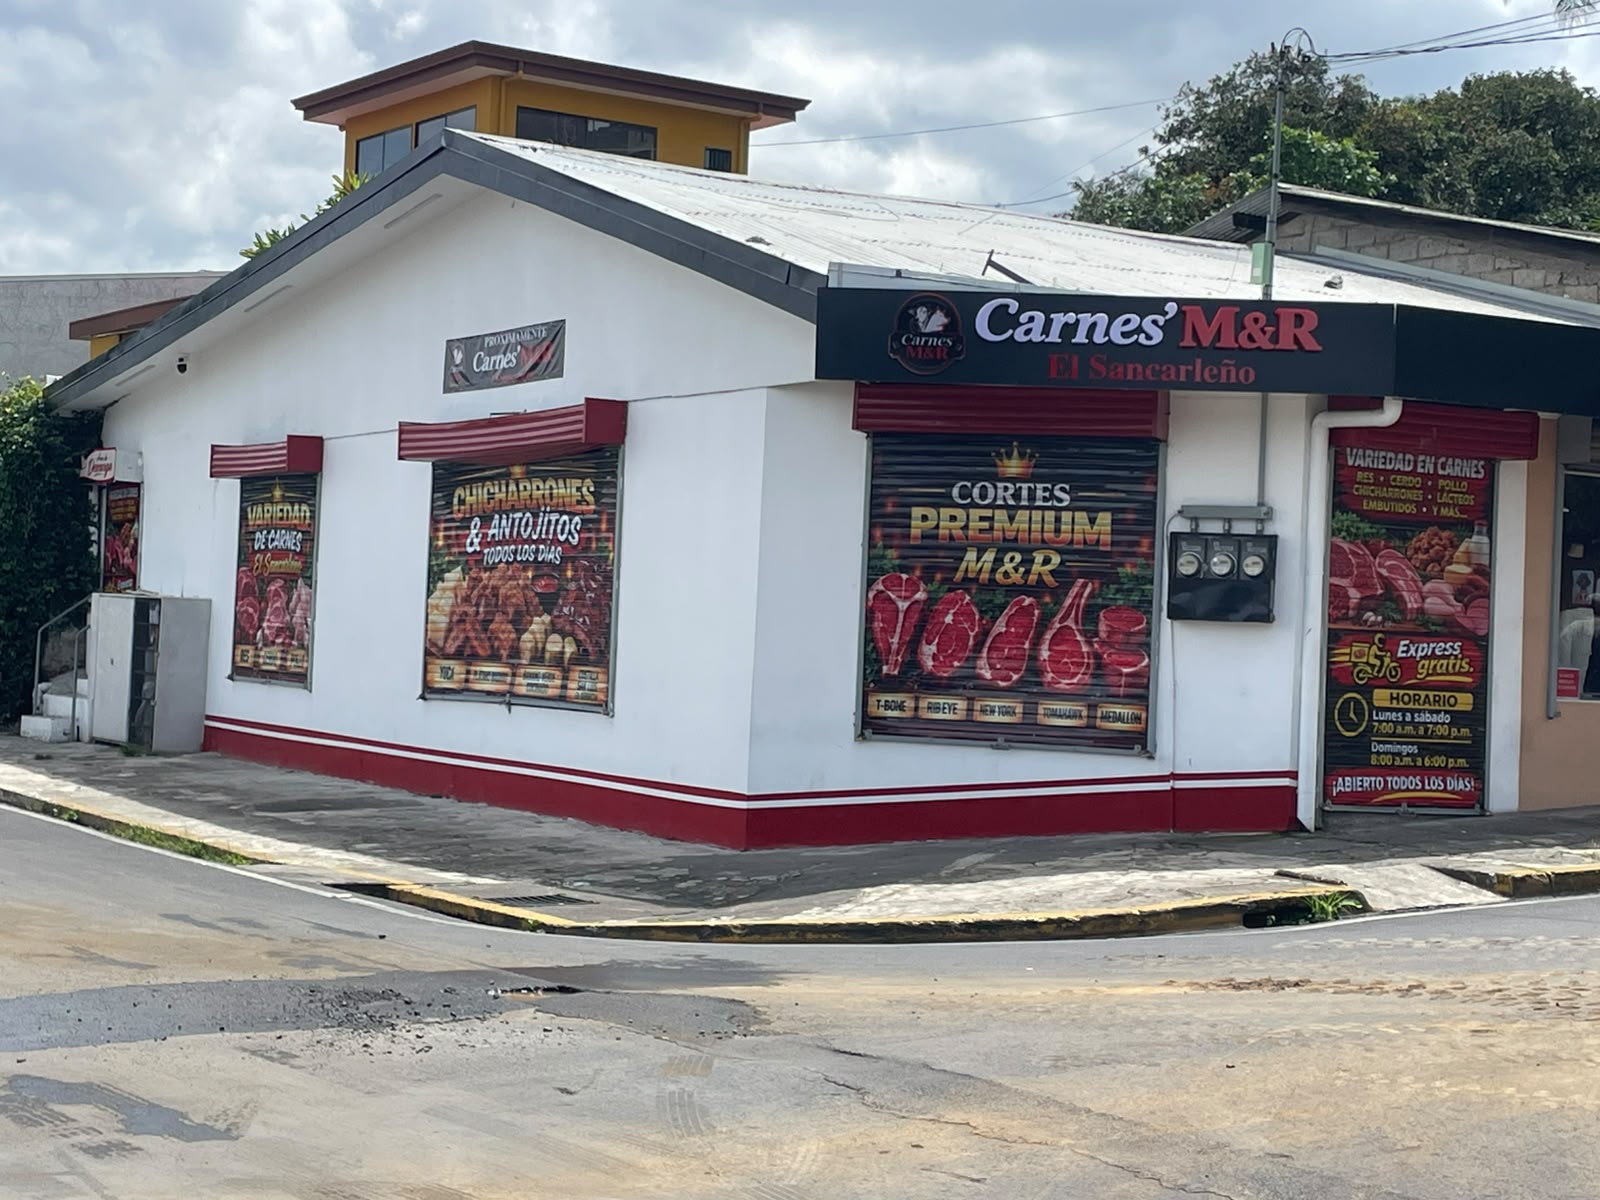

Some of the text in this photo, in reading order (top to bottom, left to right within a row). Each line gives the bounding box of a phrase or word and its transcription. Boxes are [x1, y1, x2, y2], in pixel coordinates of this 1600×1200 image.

[1180, 304, 1323, 352] M&R
[901, 333, 953, 347] Carnes
[906, 345, 949, 360] M&R
[1048, 354, 1256, 385] El Sancarleño
[1346, 448, 1486, 480] VARIEDAD EN CARNES
[1356, 471, 1468, 492] RES CERDO POLLO
[453, 477, 596, 520] CHICHARRONES
[951, 481, 1071, 507] CORTES
[1353, 484, 1424, 502] CHICHARRONES
[247, 503, 311, 527] VARIEDAD
[1363, 499, 1417, 514] EMBUTIDOS
[1432, 506, 1438, 516] Y
[466, 517, 482, 553] &
[909, 506, 1113, 551] PREMIUM
[254, 529, 303, 552] DE CARNES
[483, 545, 516, 565] TODOS
[516, 544, 536, 562] LOS
[953, 547, 1062, 588] M&R
[1397, 639, 1462, 661] Express
[876, 699, 906, 712] T-BONE
[1389, 692, 1458, 708] HORARIO
[979, 704, 1017, 718] NEW YORK
[1373, 710, 1451, 724] Lunes a sábado
[1372, 722, 1394, 734] 7:00
[1418, 726, 1424, 735] a
[1427, 724, 1449, 736] 7:00
[1451, 727, 1472, 739] p.m.
[1371, 742, 1418, 755] Domingos
[1371, 754, 1469, 769] 8:00 a.m. a 6:00 p.m.
[1333, 776, 1384, 797] ¡ABIERTO
[1386, 777, 1422, 790] TODOS
[1424, 777, 1445, 791] LOS
